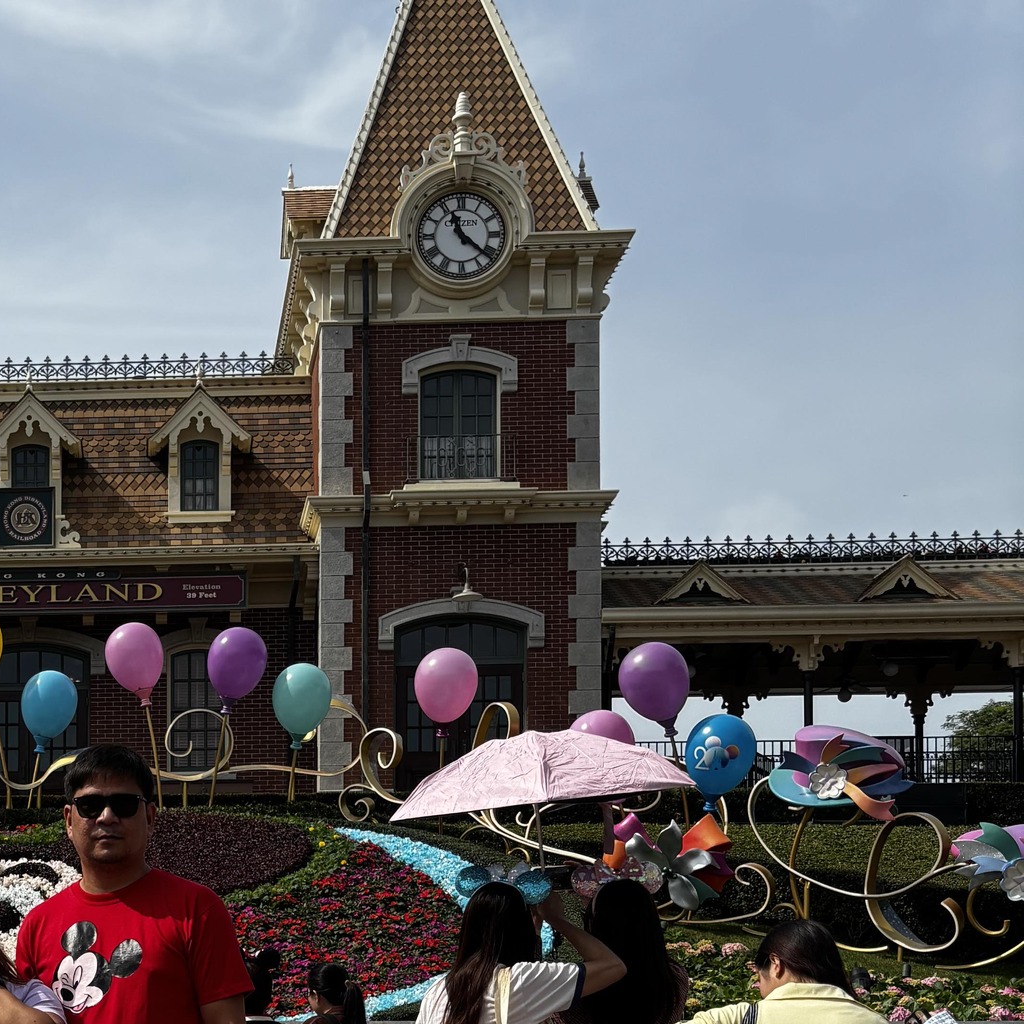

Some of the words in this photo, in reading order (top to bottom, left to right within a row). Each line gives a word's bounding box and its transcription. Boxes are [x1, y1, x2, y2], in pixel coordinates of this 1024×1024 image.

[8, 530, 42, 541] RAILROAD
[37, 571, 106, 579] KONG
[182, 583, 221, 591] Elevation
[198, 591, 217, 599] Feet
